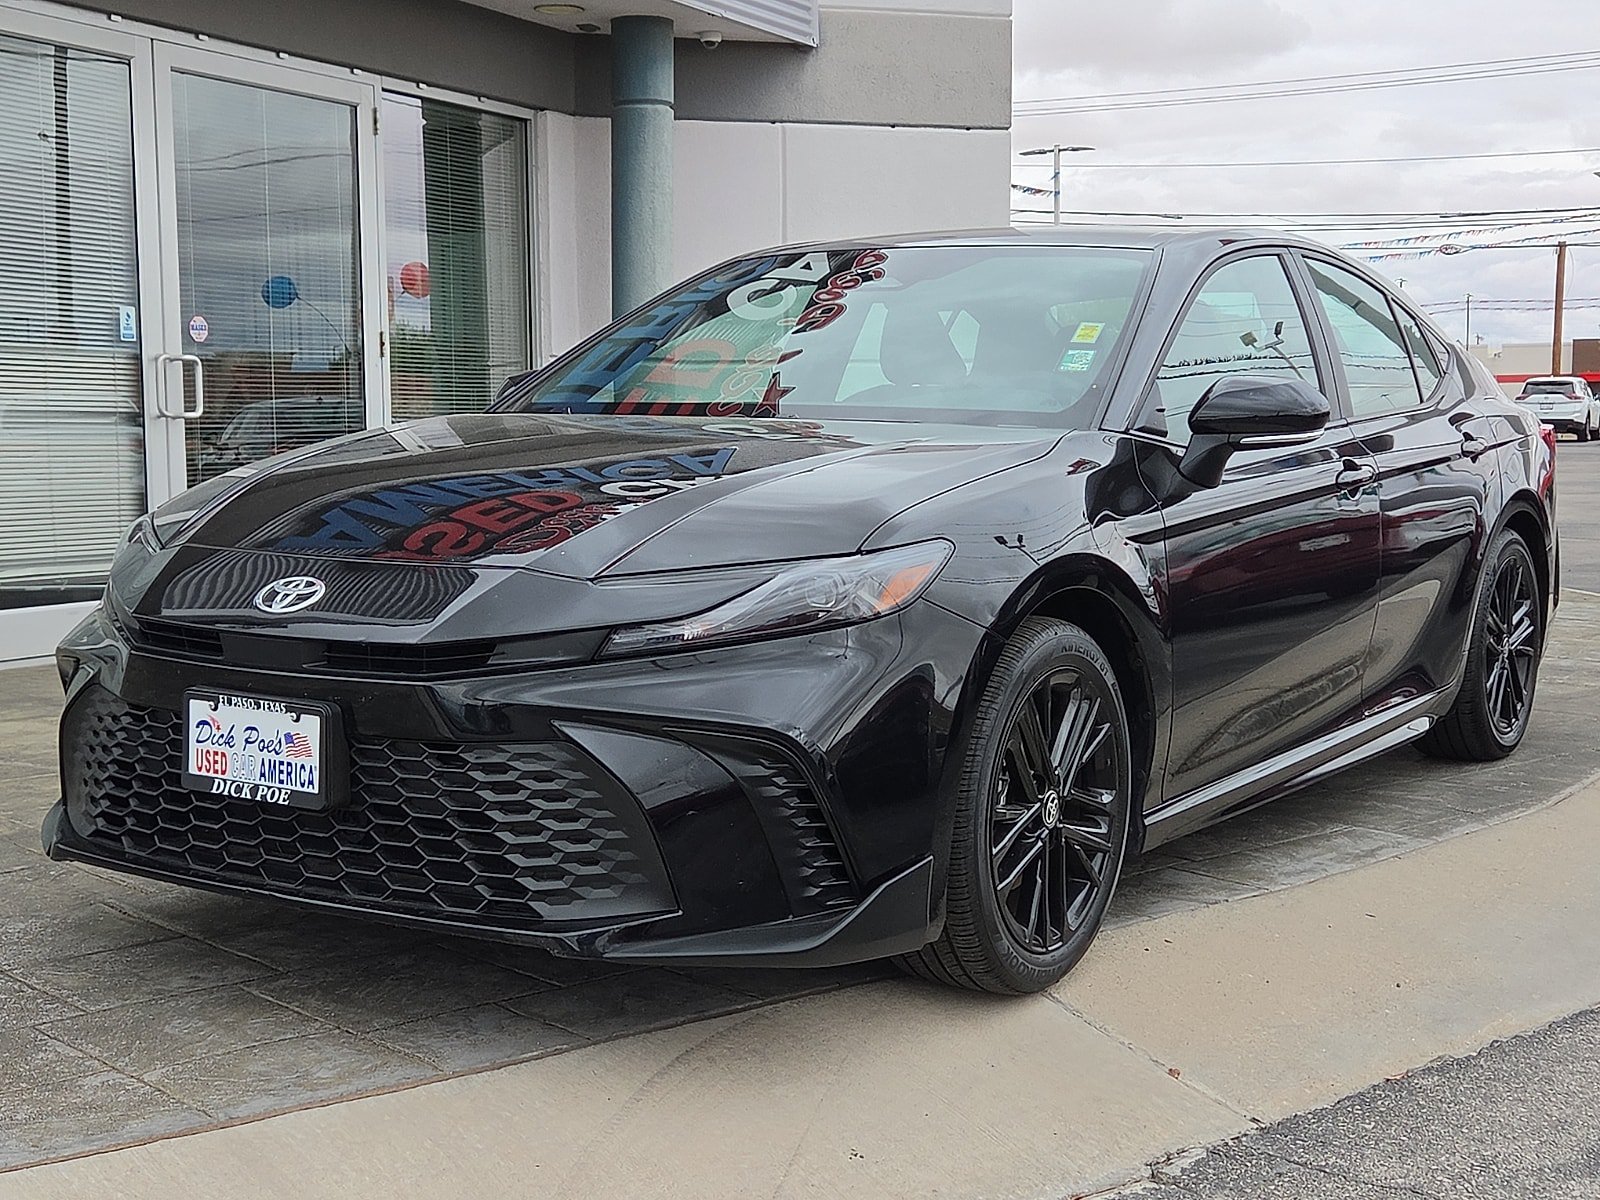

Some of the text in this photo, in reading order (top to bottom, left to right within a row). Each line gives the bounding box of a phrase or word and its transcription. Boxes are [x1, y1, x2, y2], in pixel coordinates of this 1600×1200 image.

[219, 695, 230, 706] EL
[259, 700, 287, 714] TEXAS
[195, 720, 284, 756] Dick Poe's
[195, 748, 316, 790] USED CAR AMERICA
[211, 779, 292, 806] DICK POE
